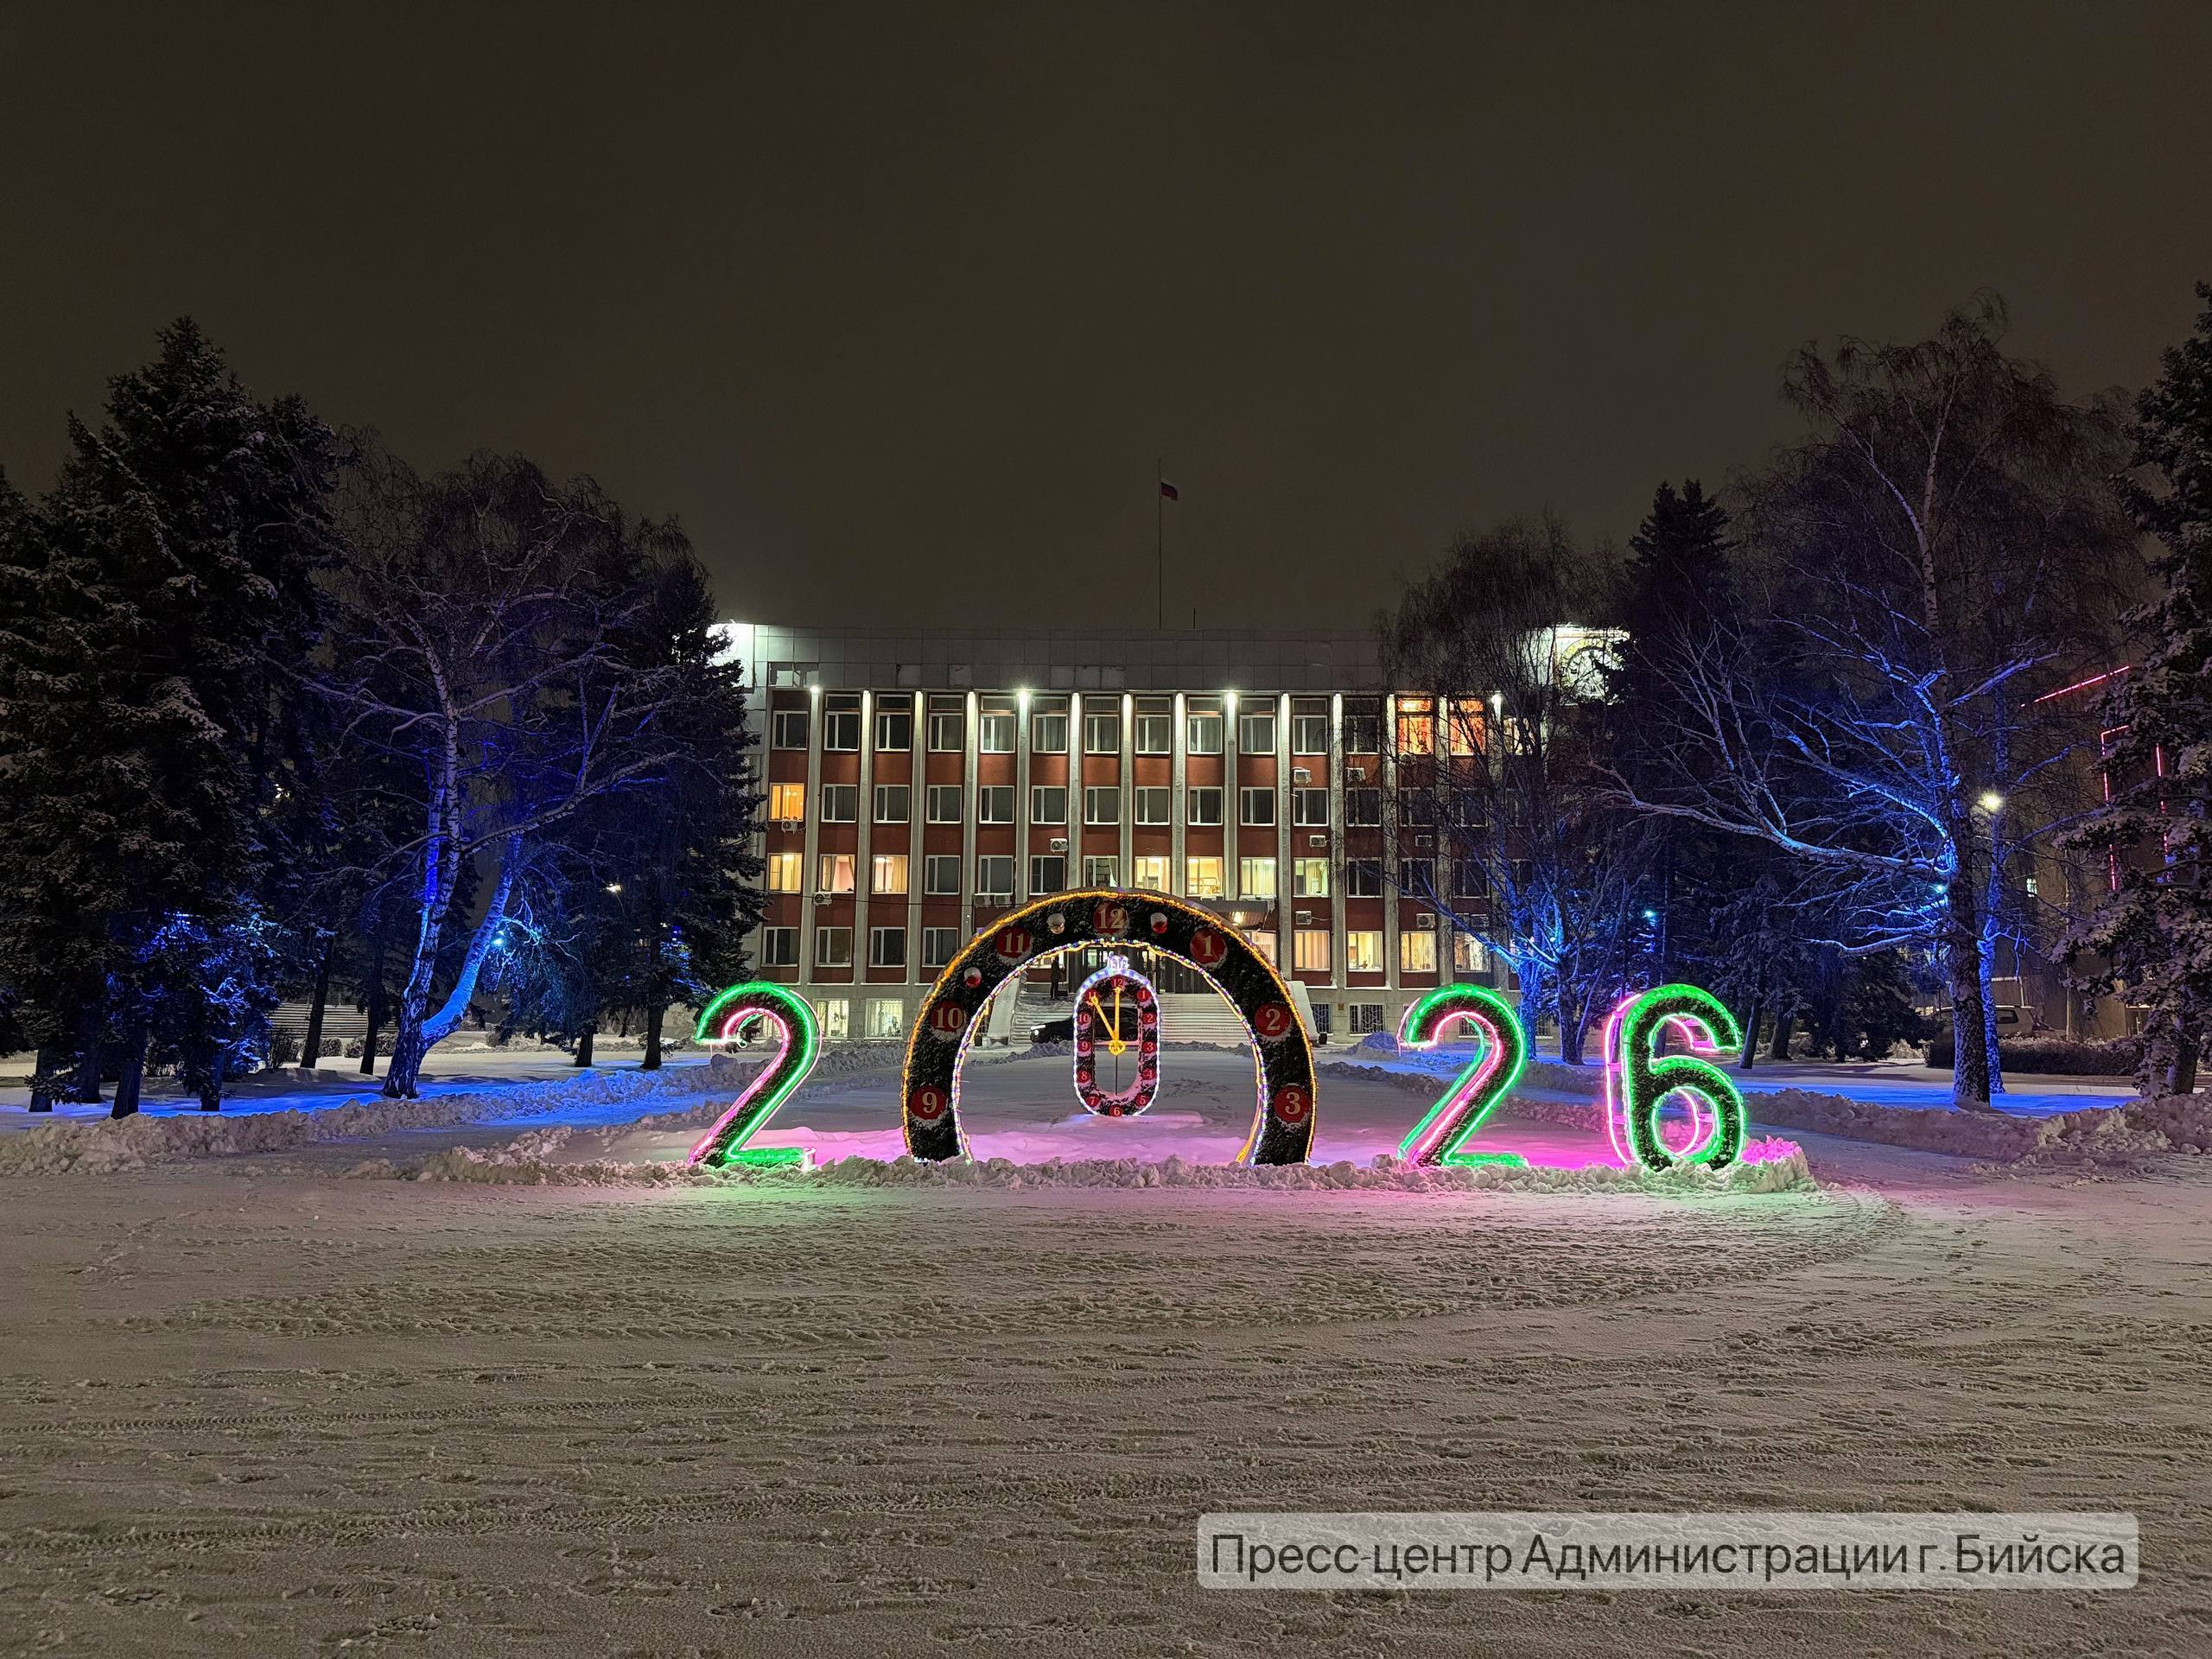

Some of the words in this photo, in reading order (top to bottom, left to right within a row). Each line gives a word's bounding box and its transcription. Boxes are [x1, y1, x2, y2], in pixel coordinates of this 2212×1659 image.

[1096, 906, 1127, 931] 12
[1003, 931, 1027, 954] 11
[1203, 936, 1214, 957] 1
[1112, 978, 1123, 987] 12
[936, 1007, 963, 1028] 10
[1078, 1014, 1090, 1023] 10
[1147, 1014, 1154, 1023] 2
[1265, 1008, 1282, 1031] 2
[1081, 1041, 1089, 1051] 9
[1147, 1042, 1155, 1052] 3
[1081, 1071, 1089, 1080] 8
[1147, 1070, 1154, 1080] 4
[923, 1091, 938, 1112] 9
[1090, 1096, 1097, 1107] 7
[1140, 1096, 1147, 1105] 5
[1284, 1091, 1300, 1114] 3
[1114, 1106, 1122, 1116] 6
